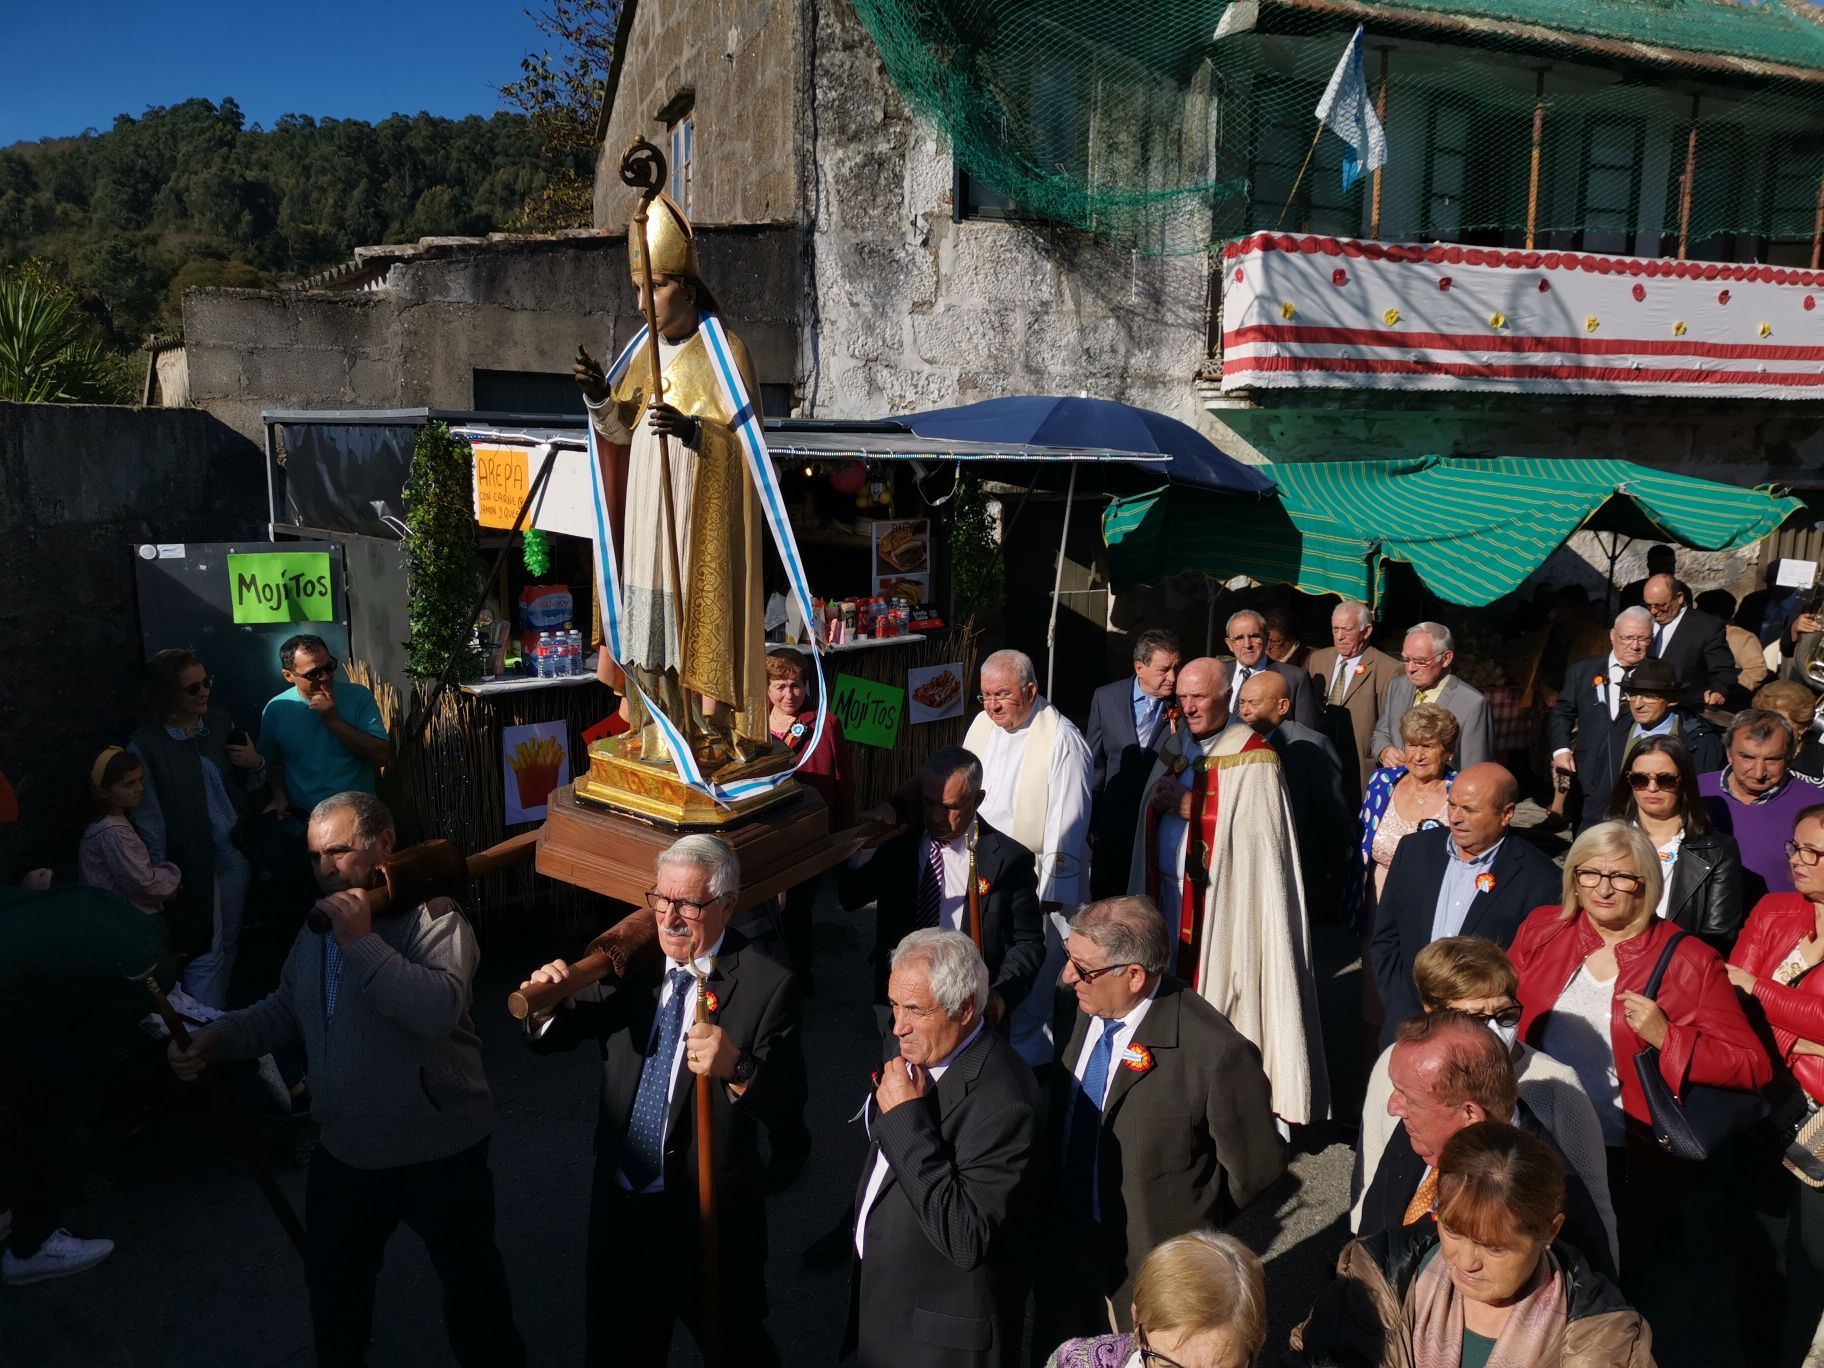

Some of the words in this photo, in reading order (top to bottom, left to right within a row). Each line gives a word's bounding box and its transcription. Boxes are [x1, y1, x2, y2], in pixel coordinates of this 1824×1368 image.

[478, 457, 523, 493] AREPA
[480, 491, 491, 501] CON
[493, 492, 516, 506] CARNE
